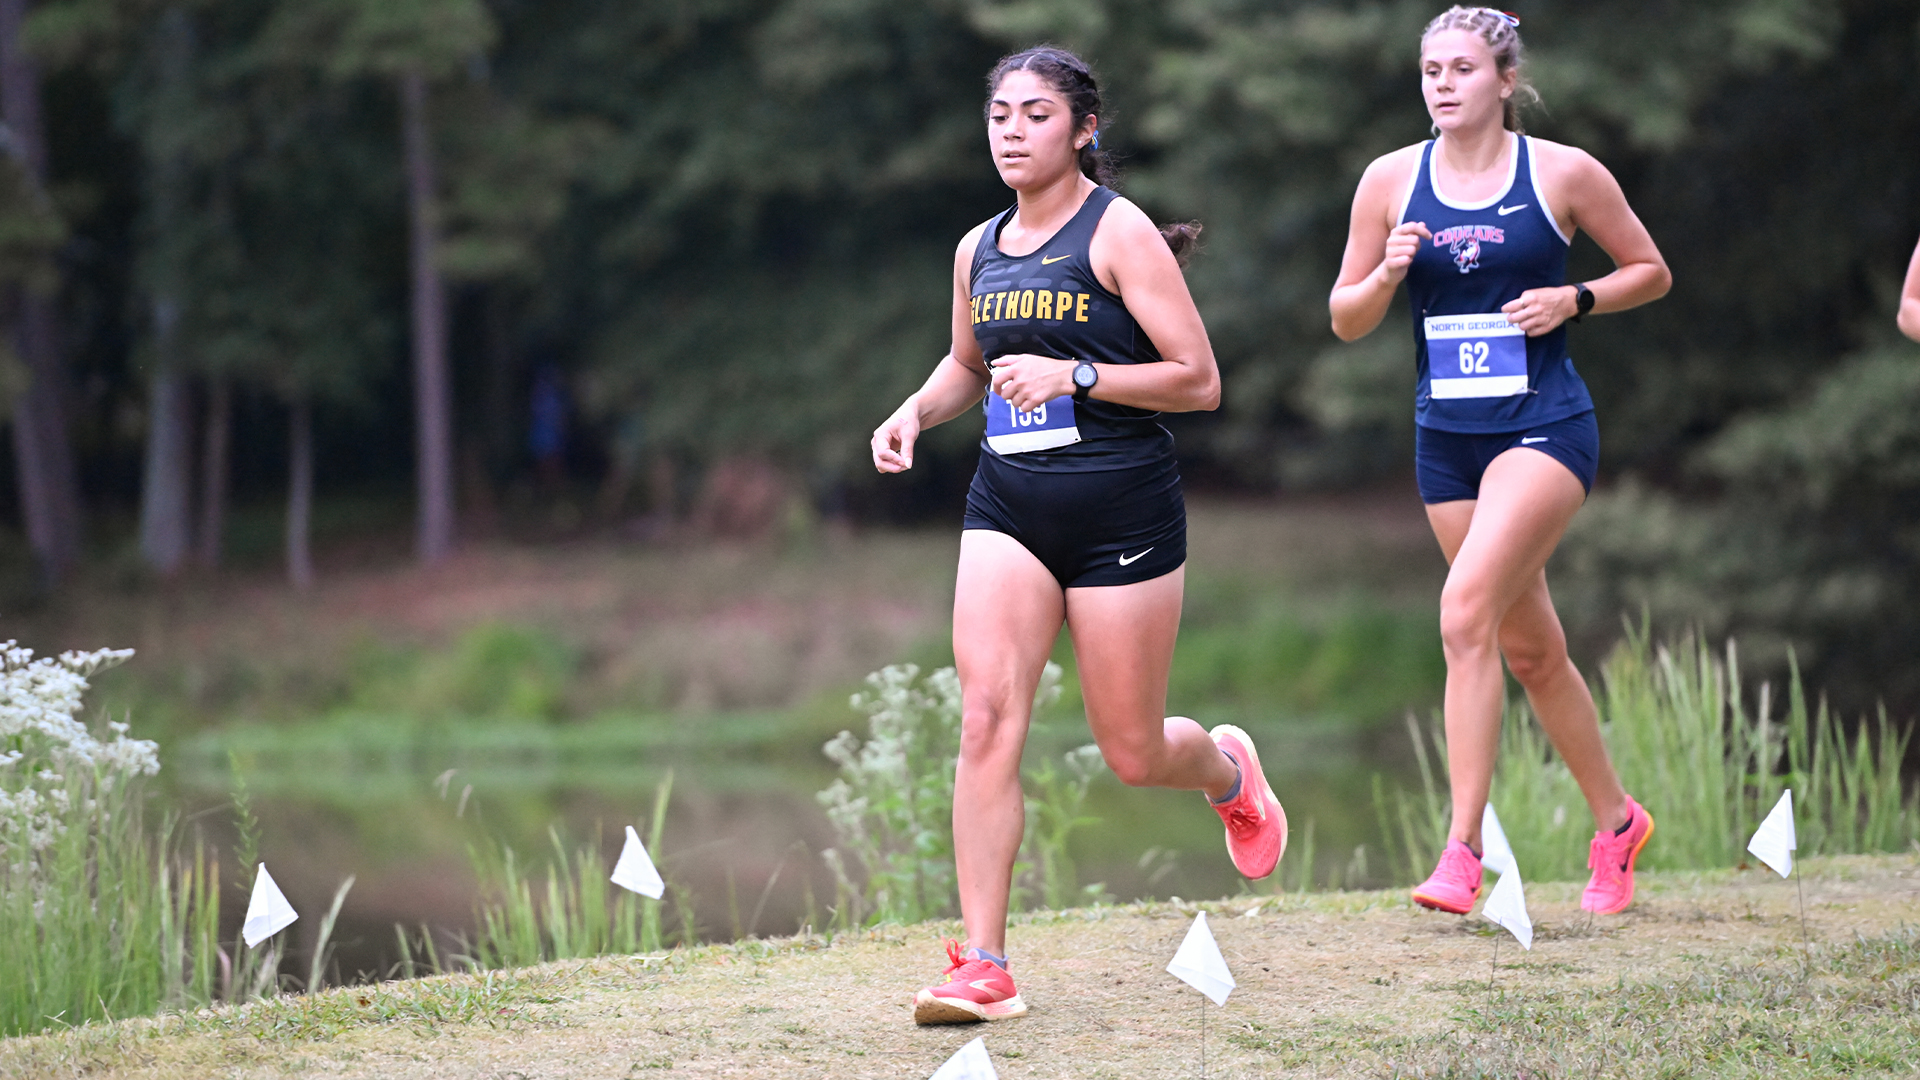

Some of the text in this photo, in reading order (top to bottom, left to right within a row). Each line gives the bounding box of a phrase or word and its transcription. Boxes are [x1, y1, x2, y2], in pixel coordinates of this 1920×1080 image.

[1433, 226, 1505, 248] COUGARS
[1431, 320, 1515, 332] NORTH GEORGIA
[1458, 341, 1490, 375] 62
